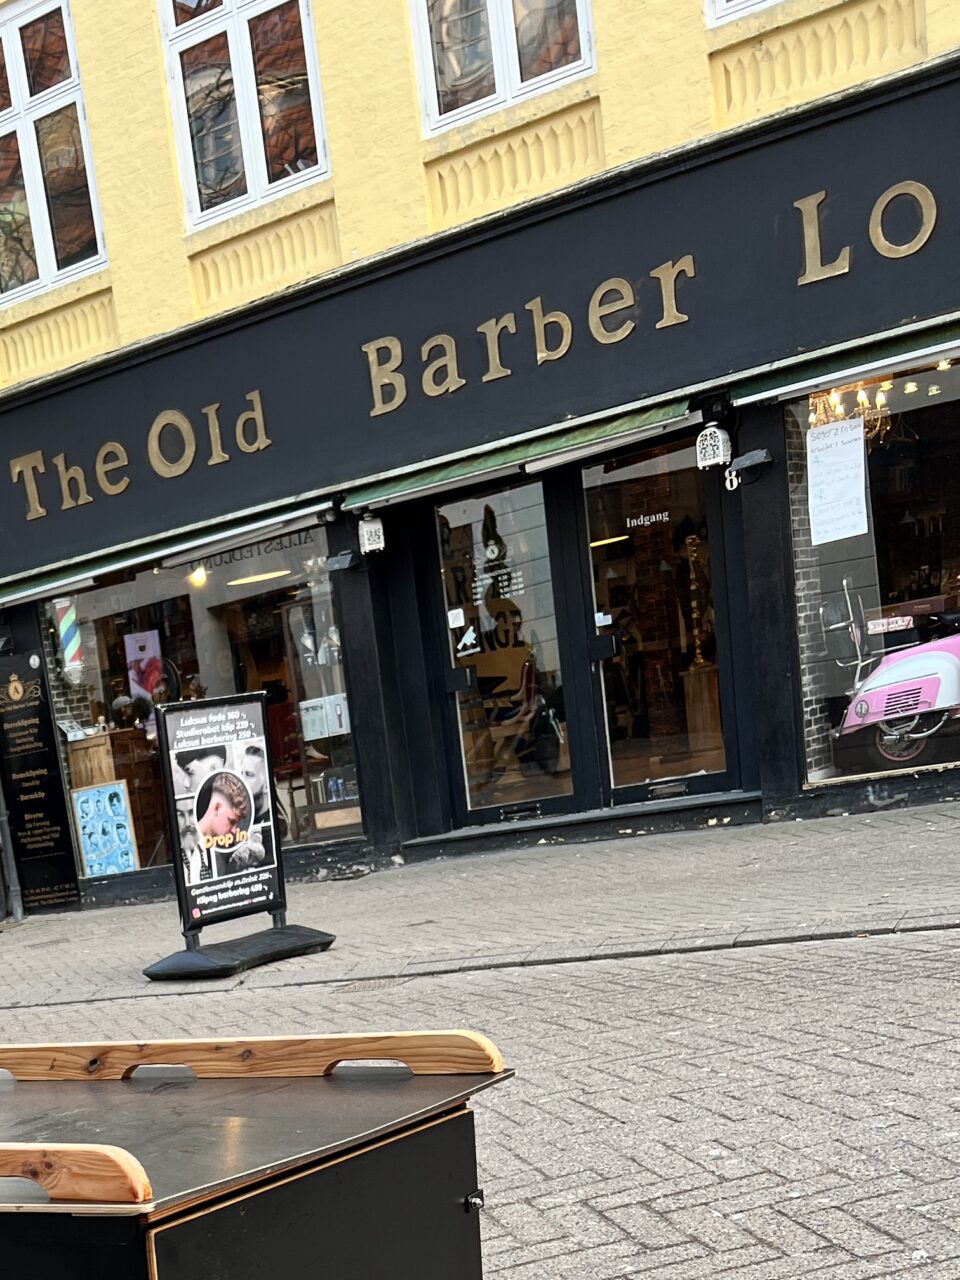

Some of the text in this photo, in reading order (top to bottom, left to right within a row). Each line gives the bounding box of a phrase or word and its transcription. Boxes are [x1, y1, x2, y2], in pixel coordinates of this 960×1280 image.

[9, 441, 129, 521] The
[147, 389, 272, 478] Old
[361, 254, 696, 418] Barber
[724, 467, 741, 490] 8
[626, 511, 670, 528] Indgang
[180, 715, 208, 727] Luksus
[173, 737, 200, 749] Luksus
[203, 828, 248, 848] Drop in
